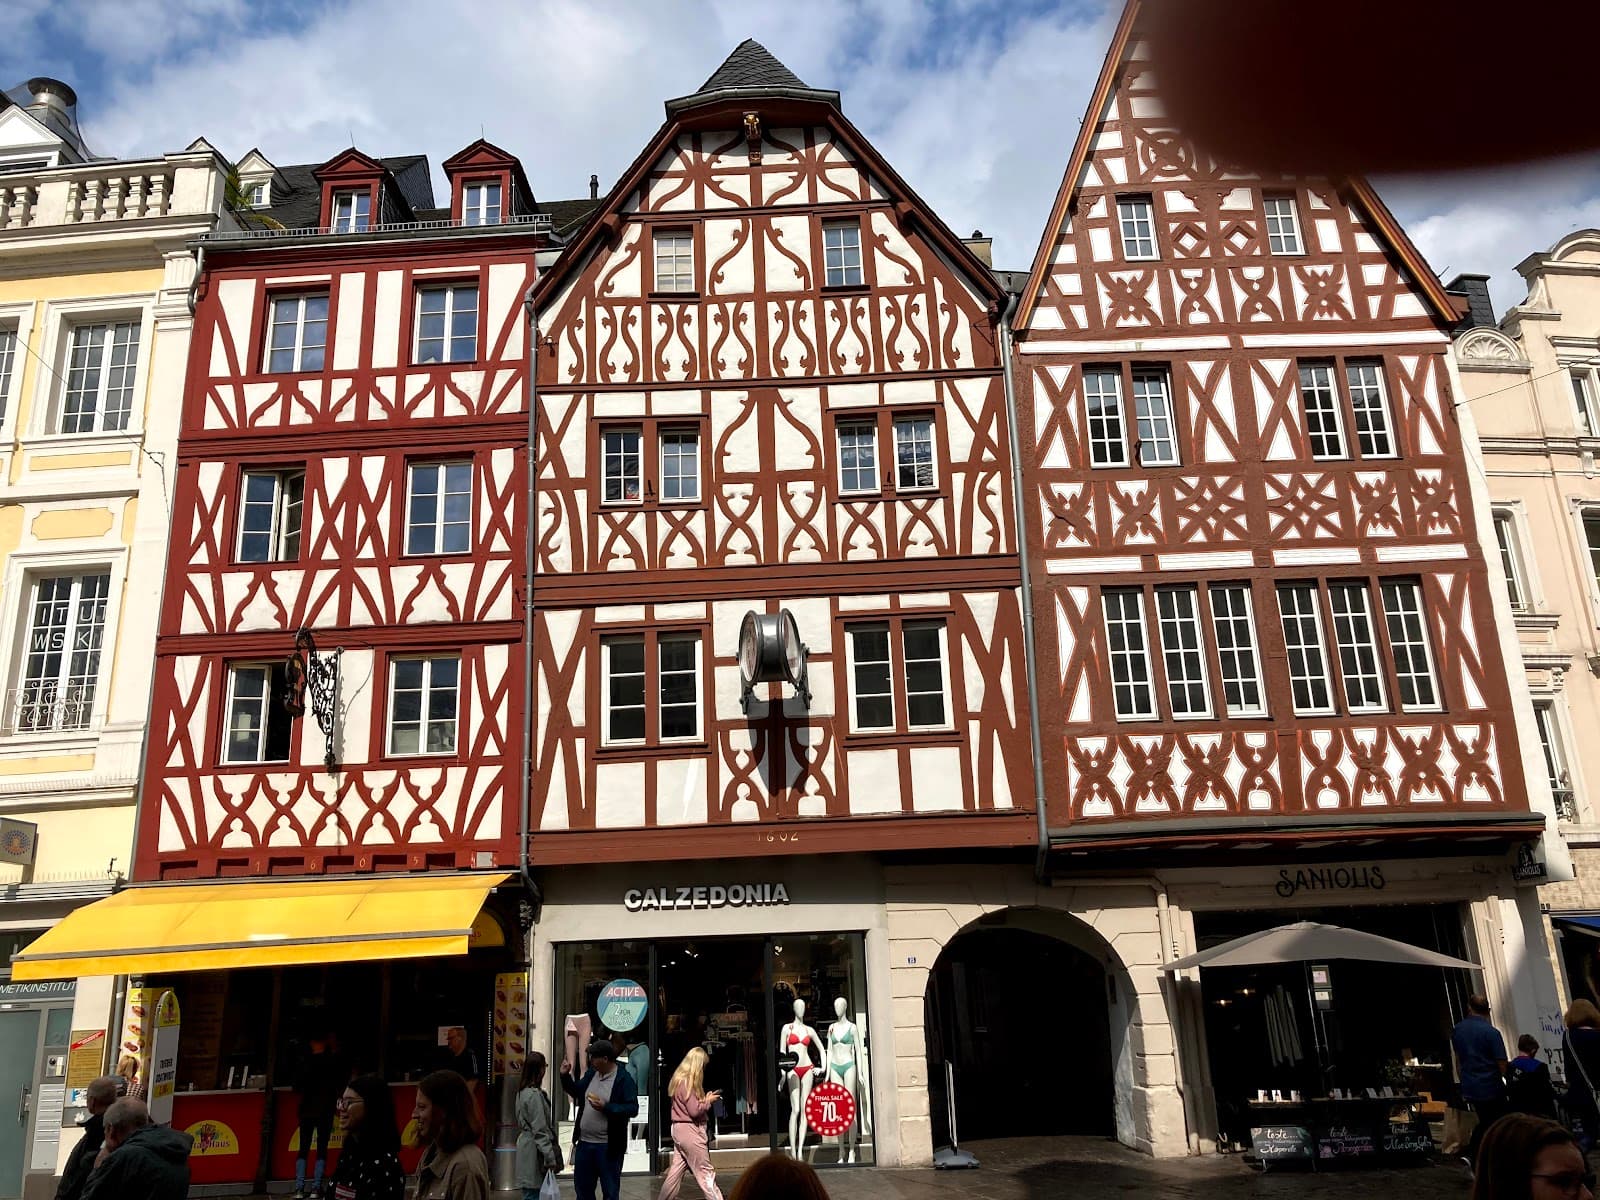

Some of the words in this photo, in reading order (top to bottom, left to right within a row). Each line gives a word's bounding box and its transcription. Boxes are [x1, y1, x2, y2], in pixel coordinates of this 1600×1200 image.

[1275, 865, 1386, 897] SANIOLIS
[624, 883, 790, 911] CALZEDONIA
[606, 986, 640, 997] ACTIVE
